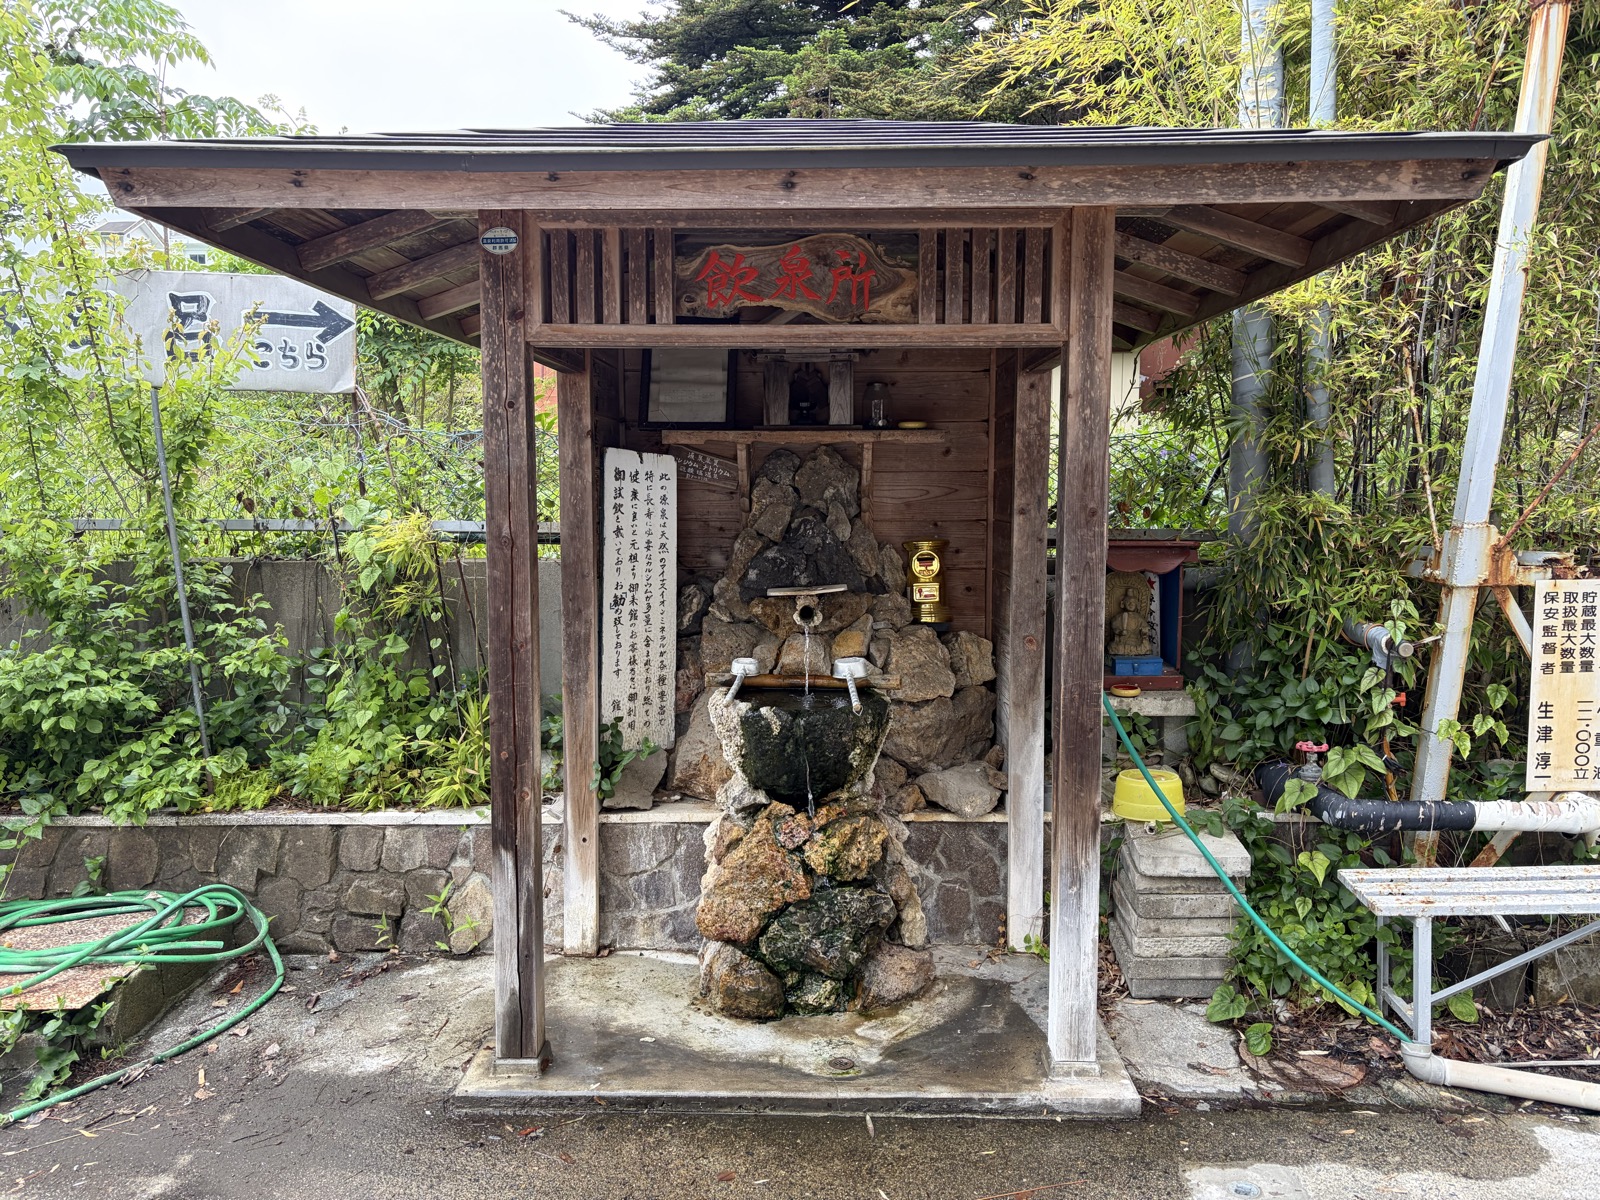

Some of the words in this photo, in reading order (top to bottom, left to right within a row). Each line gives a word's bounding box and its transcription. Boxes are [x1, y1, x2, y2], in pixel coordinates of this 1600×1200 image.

[695, 244, 876, 311] 飲泉所
[252, 338, 327, 370] こちら
[1540, 591, 1559, 675] 保安監督者
[1559, 591, 1579, 674] 取扱最大数量
[1579, 591, 1598, 673] 貯蔵最大数量
[1534, 701, 1554, 778] 生津淳一
